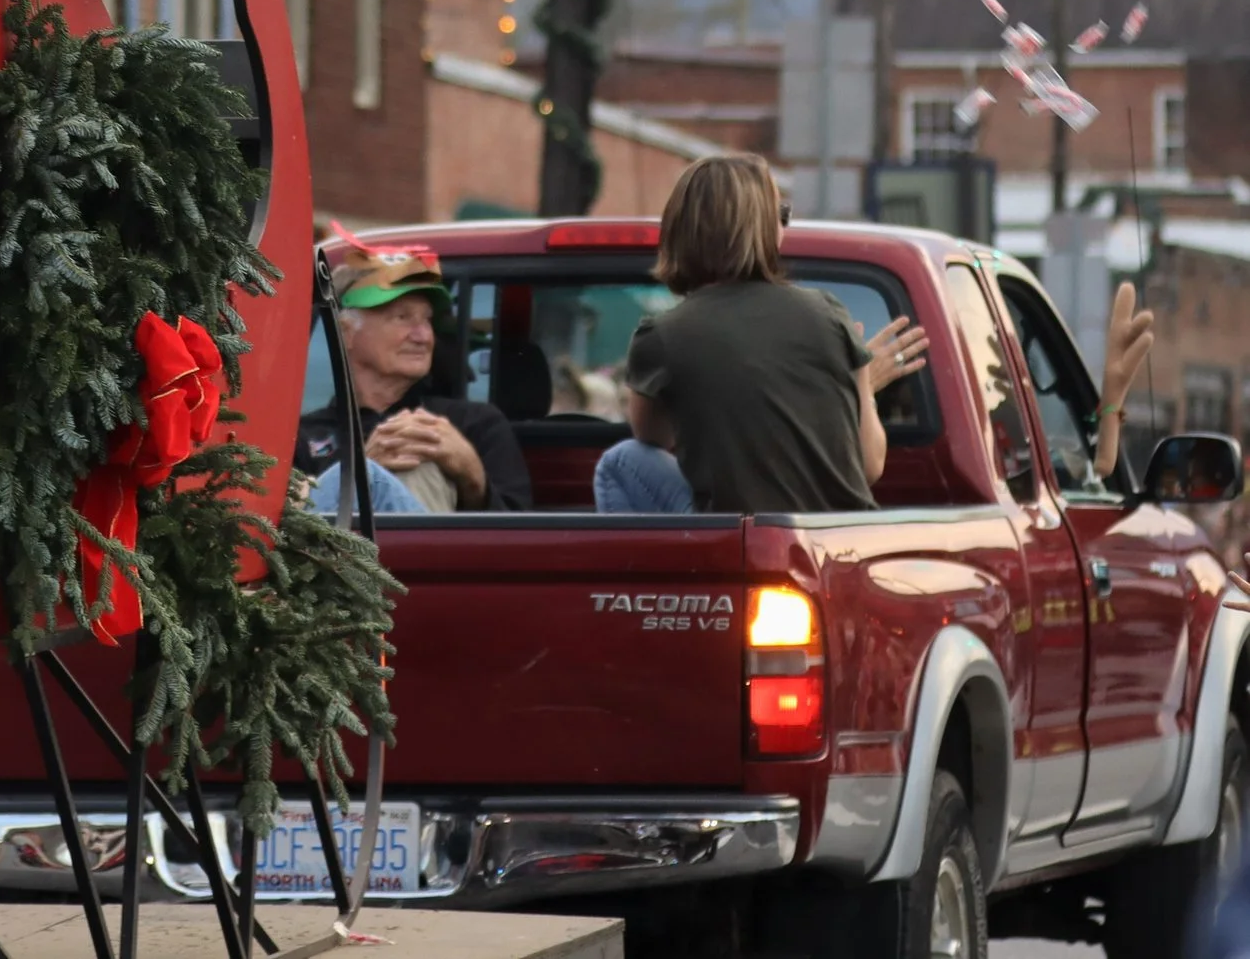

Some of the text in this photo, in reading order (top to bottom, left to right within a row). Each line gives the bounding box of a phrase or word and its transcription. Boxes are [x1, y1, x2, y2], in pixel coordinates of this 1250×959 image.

[589, 593, 734, 614] TACOMA
[641, 616, 731, 631] SR5 V6
[254, 874, 403, 891] NORTH CRLINA
